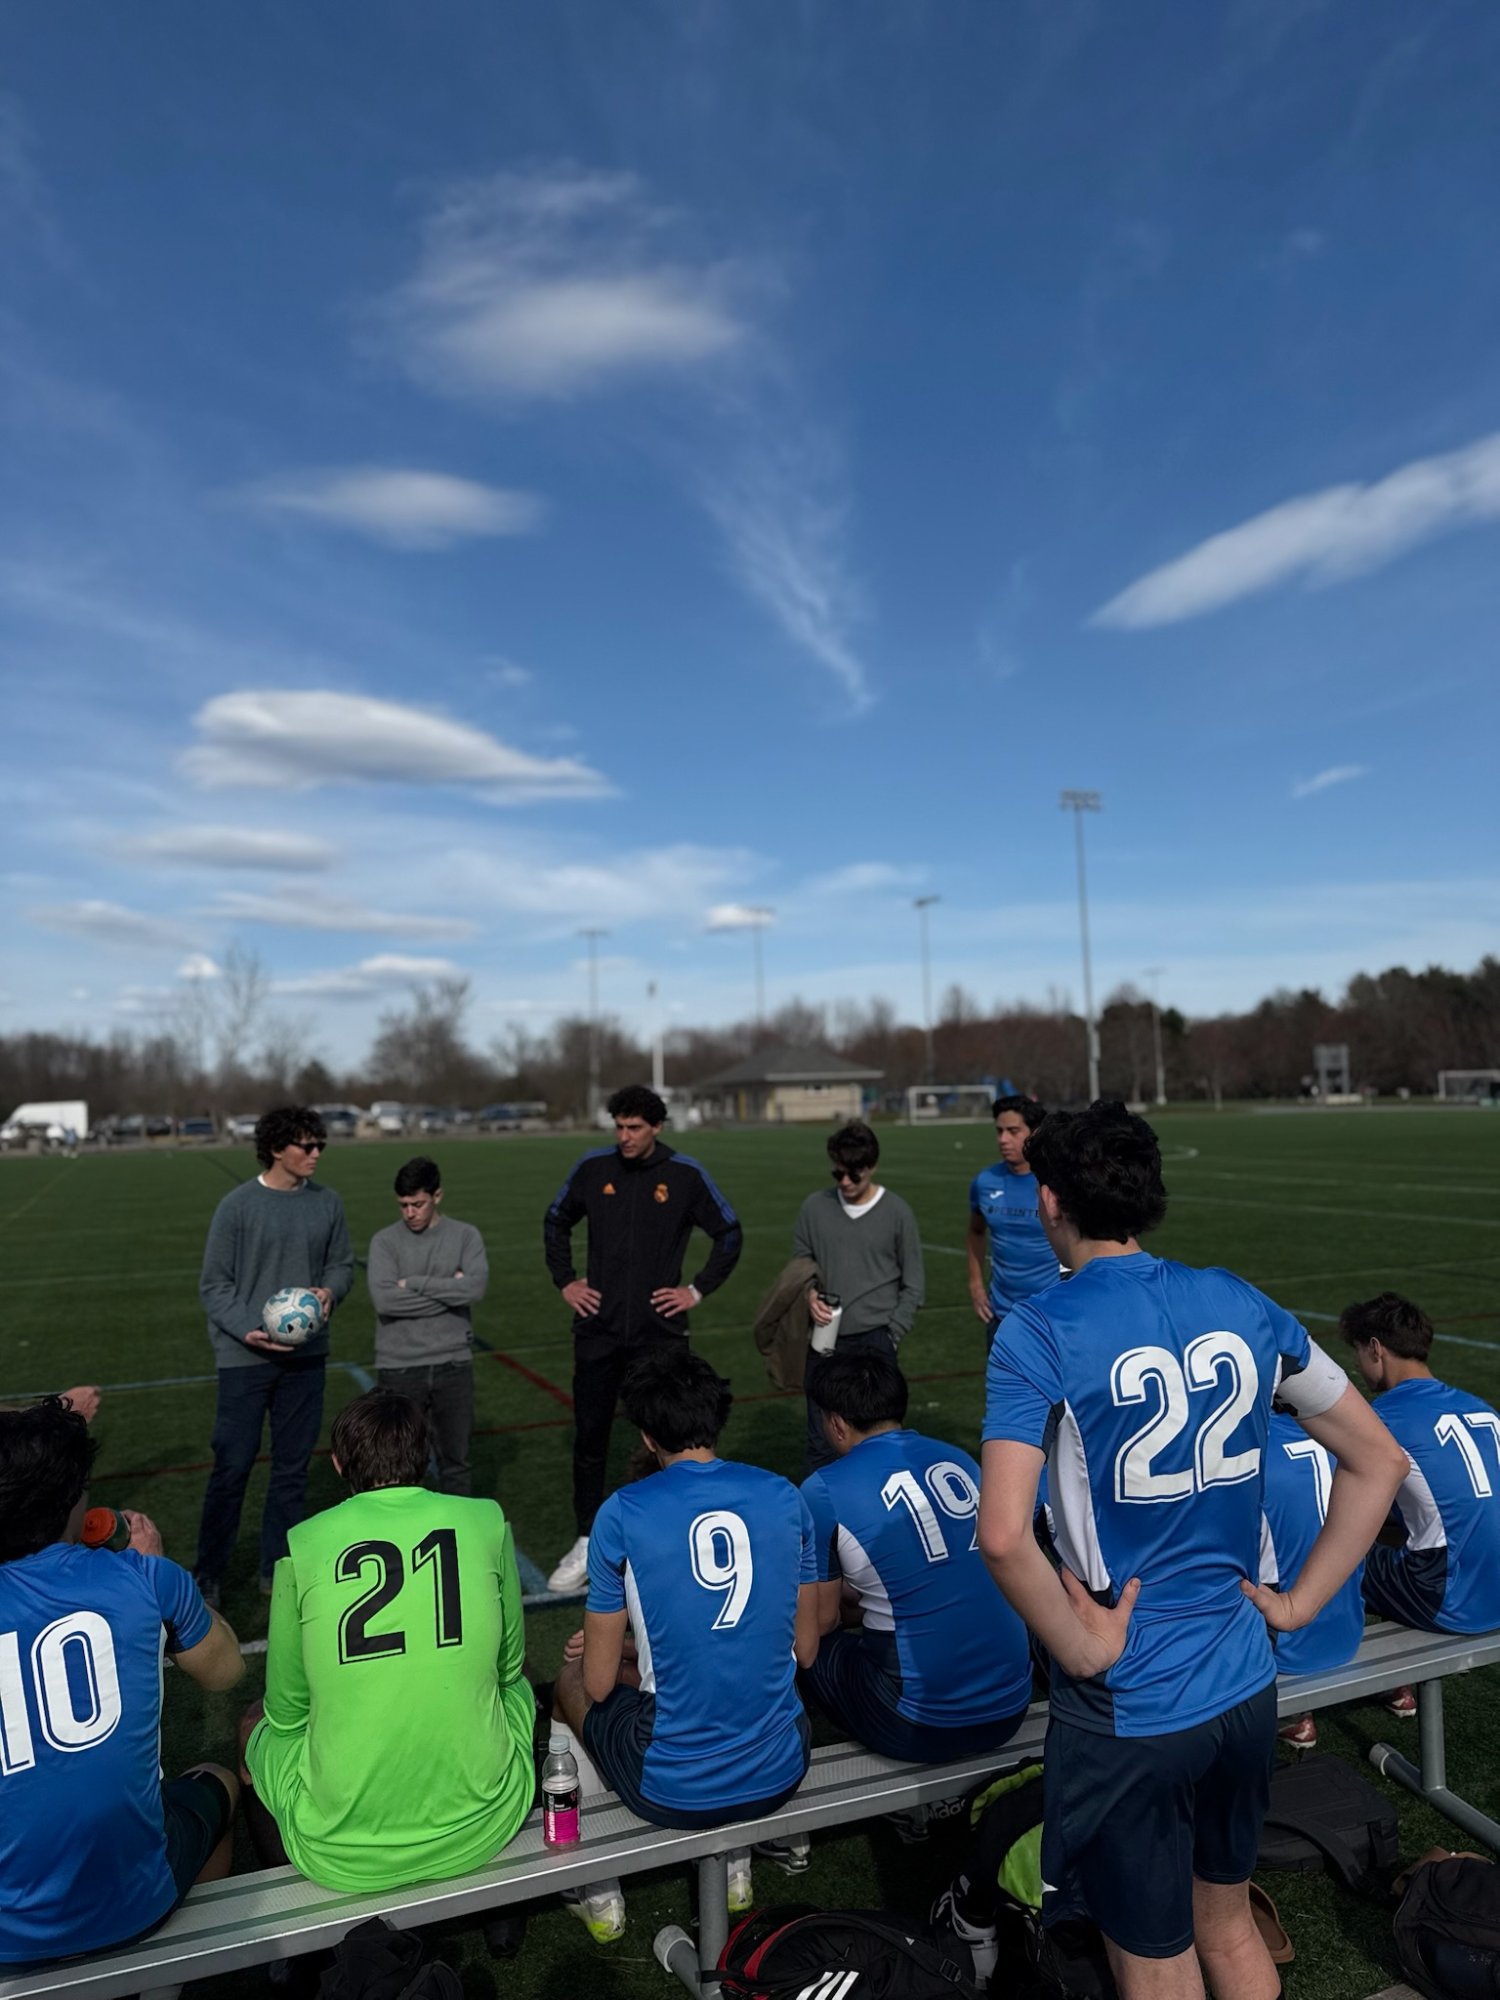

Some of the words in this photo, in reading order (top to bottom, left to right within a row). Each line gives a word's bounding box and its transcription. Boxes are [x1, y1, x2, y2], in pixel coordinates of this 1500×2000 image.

[1110, 1331, 1261, 1504] 22
[881, 1461, 980, 1562] 19
[1282, 1438, 1334, 1526] 7
[335, 1529, 463, 1664] 21
[688, 1510, 753, 1631] 9
[0, 1610, 122, 1776] 10
